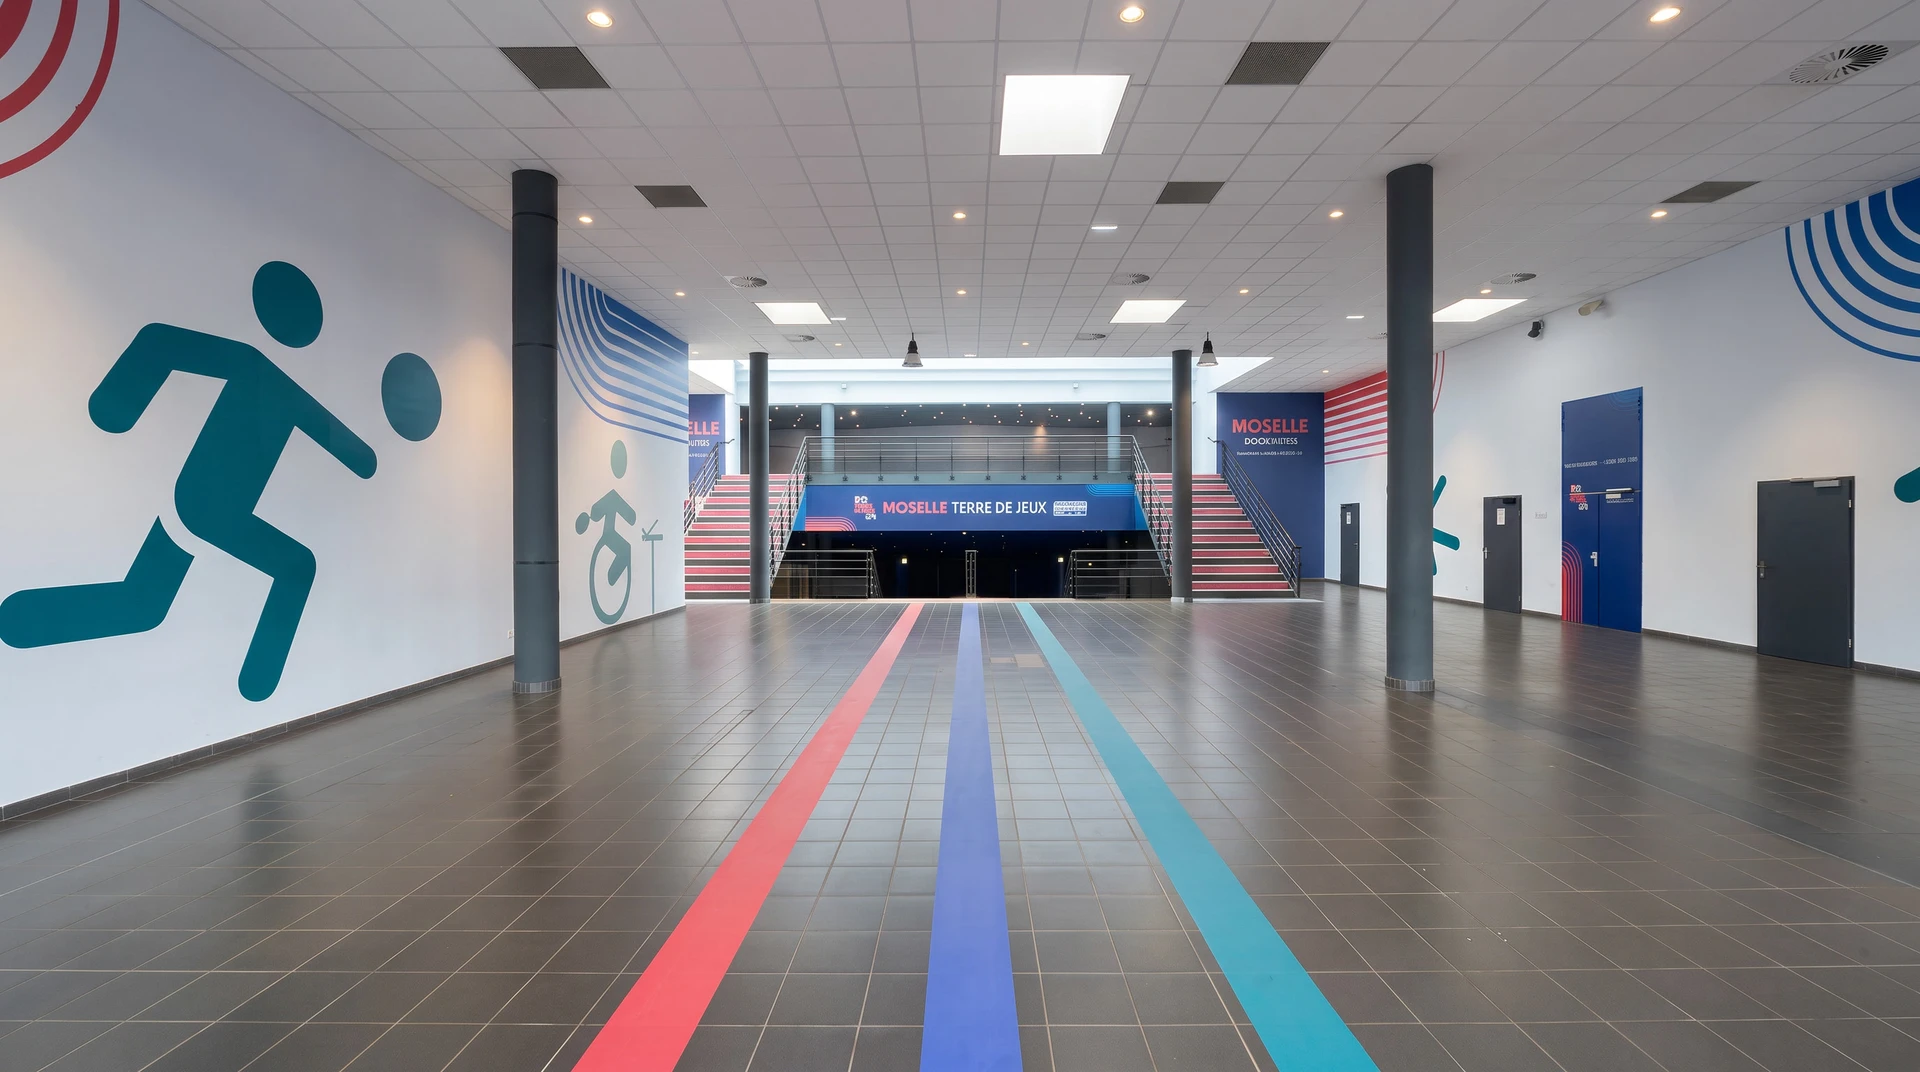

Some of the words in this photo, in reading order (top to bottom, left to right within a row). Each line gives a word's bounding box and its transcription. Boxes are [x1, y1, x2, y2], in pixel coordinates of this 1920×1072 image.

[1232, 418, 1308, 434] MOSELLE
[883, 501, 947, 514] MOSELLE
[951, 501, 992, 514] TERRE
[995, 501, 1013, 514] DE
[1015, 501, 1047, 514] JEUX
